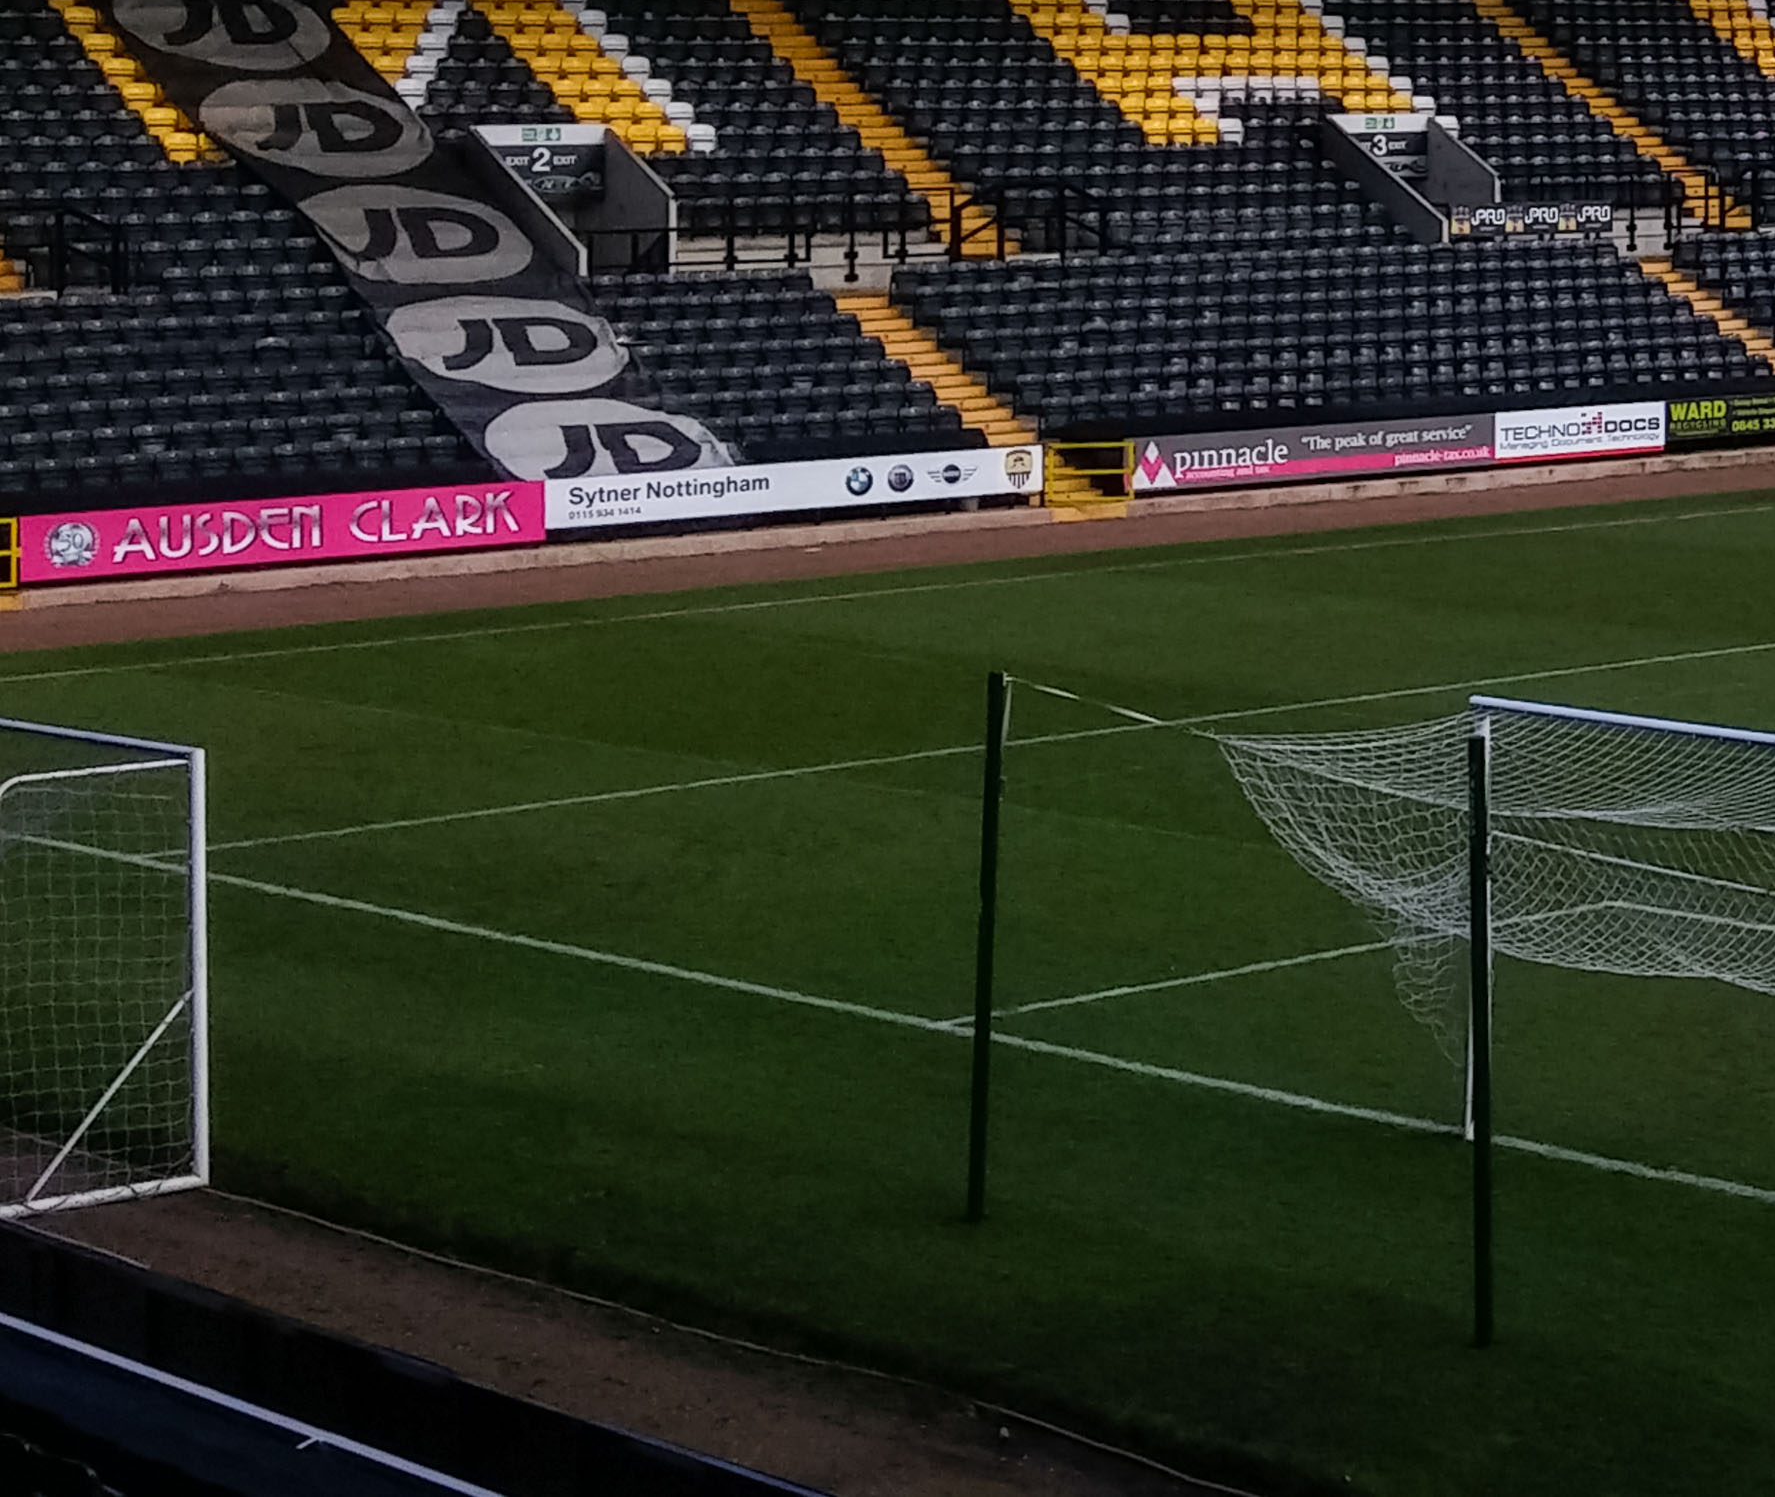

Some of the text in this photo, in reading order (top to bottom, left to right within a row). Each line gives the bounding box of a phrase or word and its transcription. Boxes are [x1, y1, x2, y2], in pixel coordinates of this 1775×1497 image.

[255, 101, 403, 152] JD
[531, 147, 551, 172] 2
[553, 155, 577, 166] EXIT
[1372, 135, 1388, 155] 3
[353, 206, 499, 262] JD
[441, 317, 597, 370] JD
[1669, 400, 1727, 421] WARD
[543, 422, 702, 479] JD
[1335, 433, 1367, 451] peak
[1368, 431, 1384, 446] of
[1385, 430, 1419, 447] great
[1499, 432, 1660, 450] Managing Document Technology
[1173, 439, 1289, 479] pinnacle
[569, 475, 770, 508] Sytner Nottingham
[112, 490, 521, 564] AUSDEN CLARK
[568, 511, 594, 520] 0115
